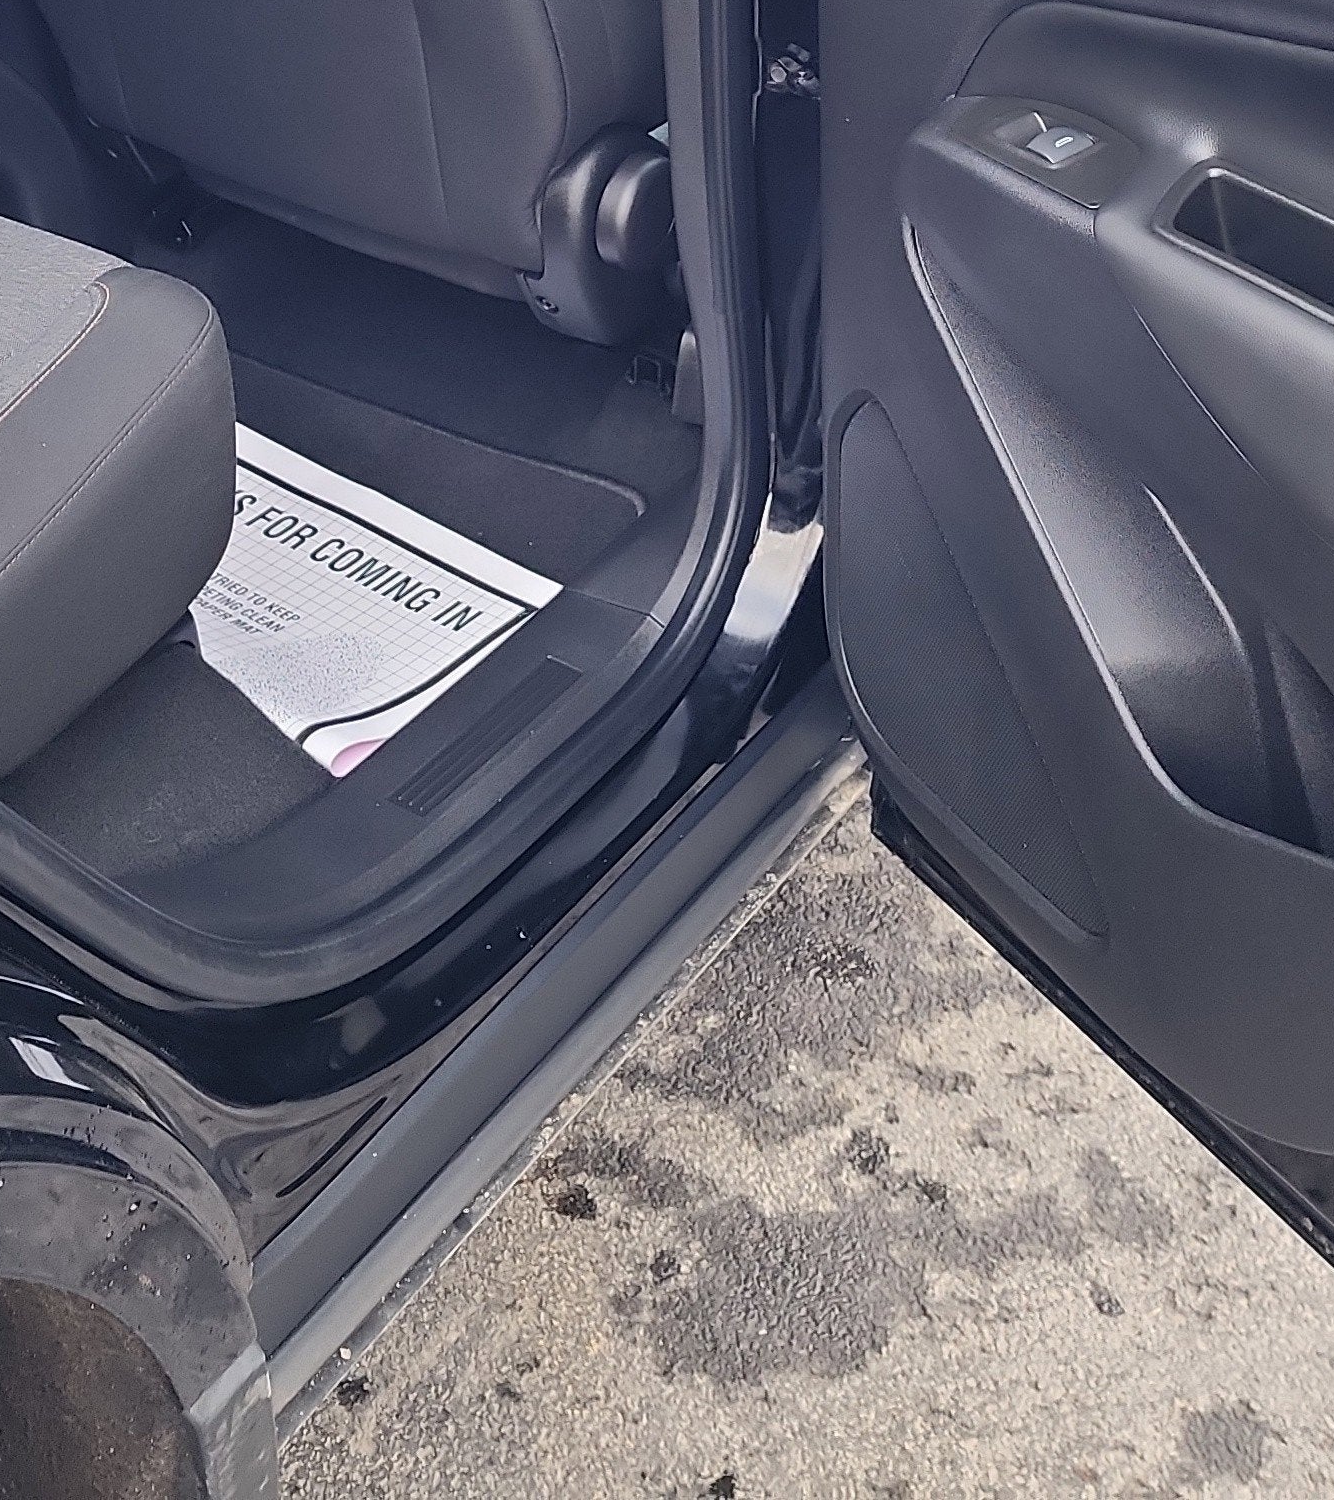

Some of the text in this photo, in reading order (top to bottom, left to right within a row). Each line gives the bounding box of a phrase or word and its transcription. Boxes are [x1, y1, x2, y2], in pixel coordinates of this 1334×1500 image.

[245, 506, 318, 550] FOR
[310, 538, 441, 612] COMING
[431, 601, 484, 632] IN
[211, 572, 300, 621] TRIED TO KEEP
[230, 618, 263, 634] MAT
[240, 608, 285, 632] CLEAN
